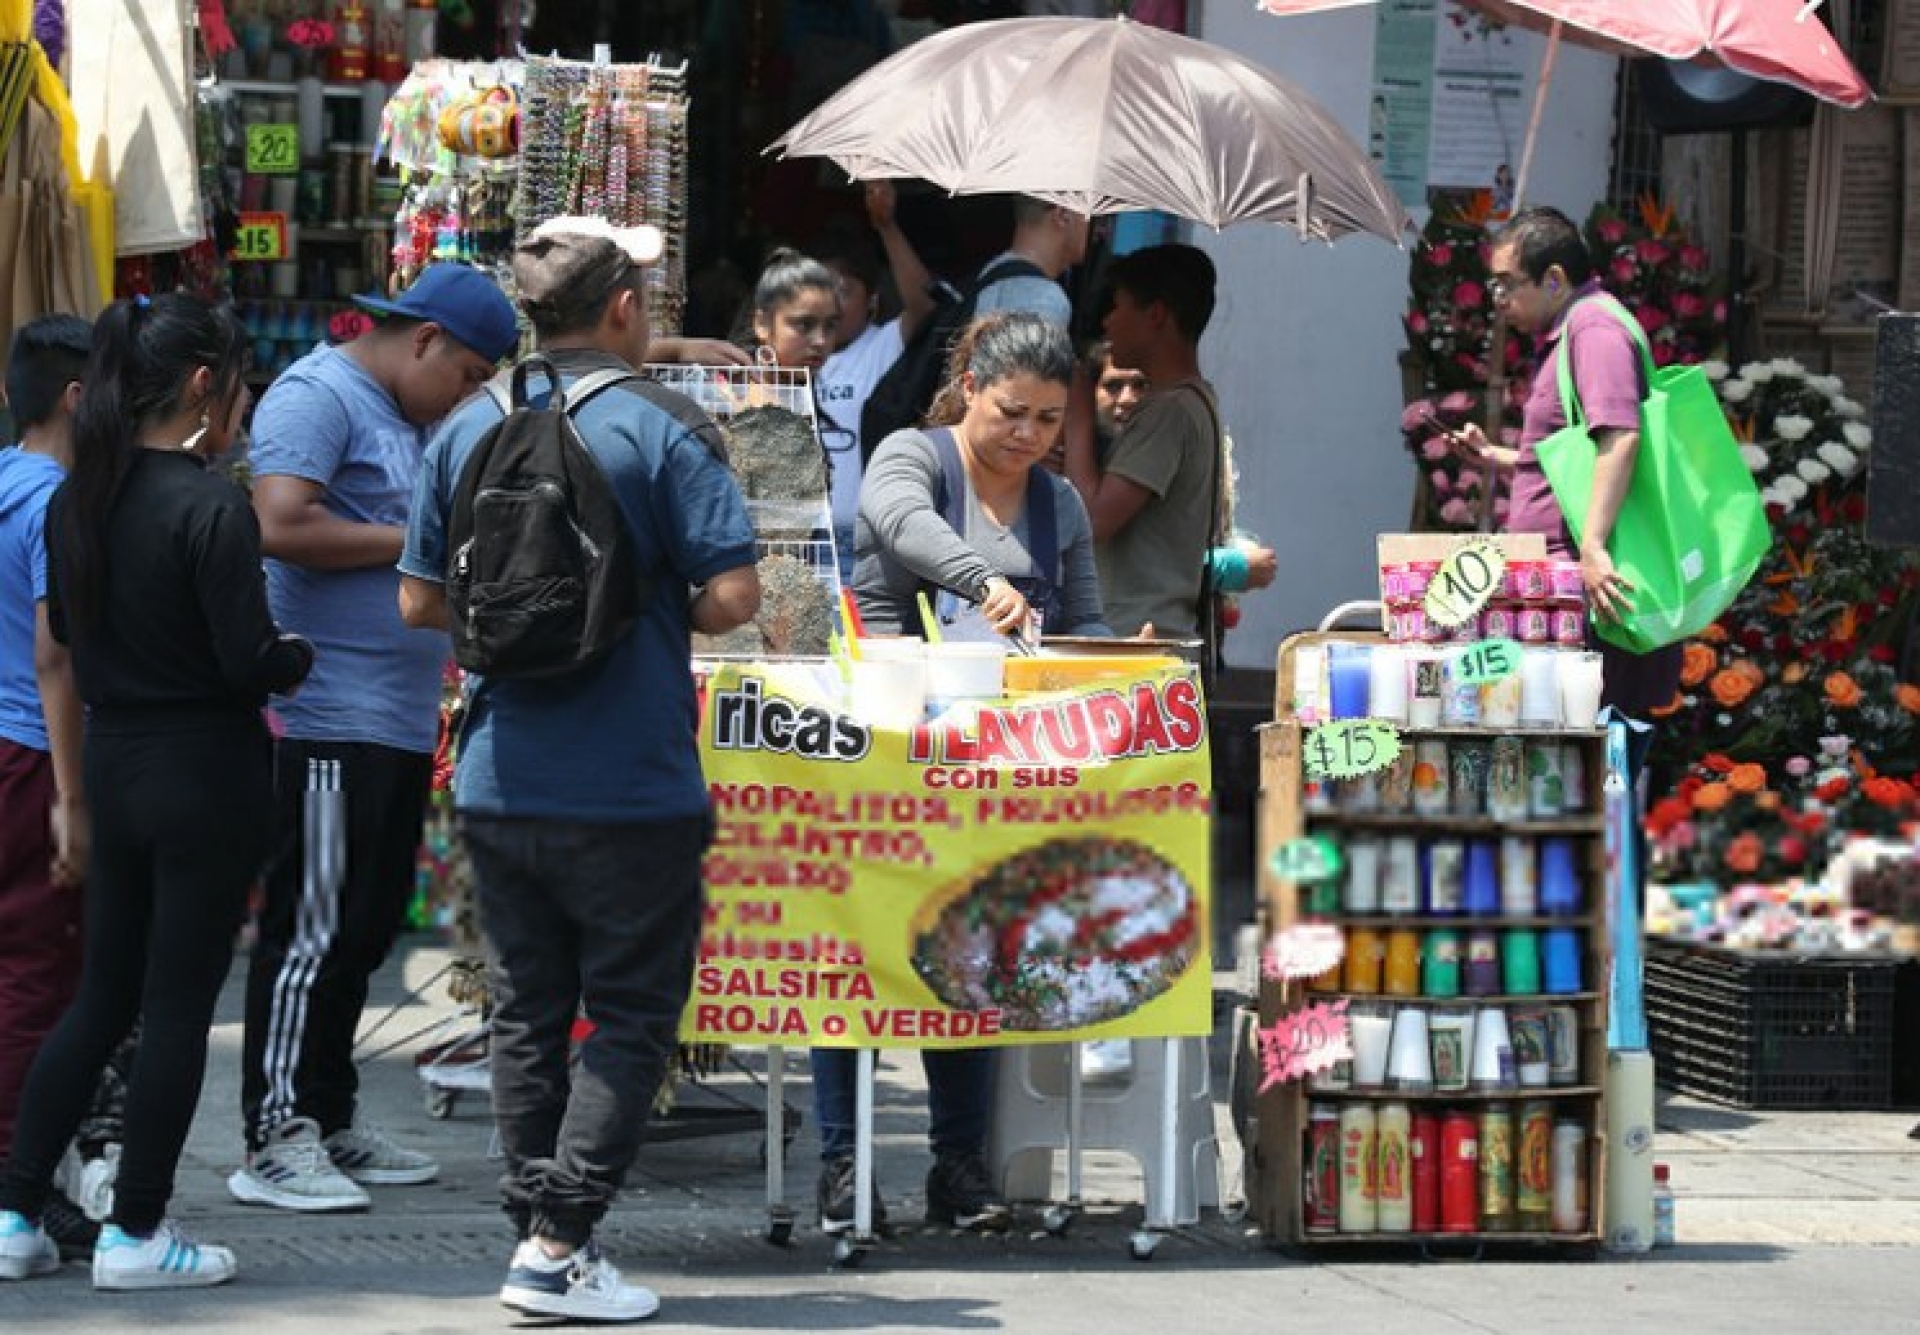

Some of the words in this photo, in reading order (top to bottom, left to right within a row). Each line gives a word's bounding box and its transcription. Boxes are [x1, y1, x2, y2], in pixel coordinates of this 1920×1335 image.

[1460, 644, 1510, 677] $15
[715, 677, 873, 762] ricas
[923, 767, 998, 789] con
[1012, 767, 1079, 788] sus
[698, 967, 875, 1000] SALSITA
[696, 1004, 808, 1035] ROJA
[821, 1014, 848, 1036] o
[862, 1009, 1002, 1037] VERDE
